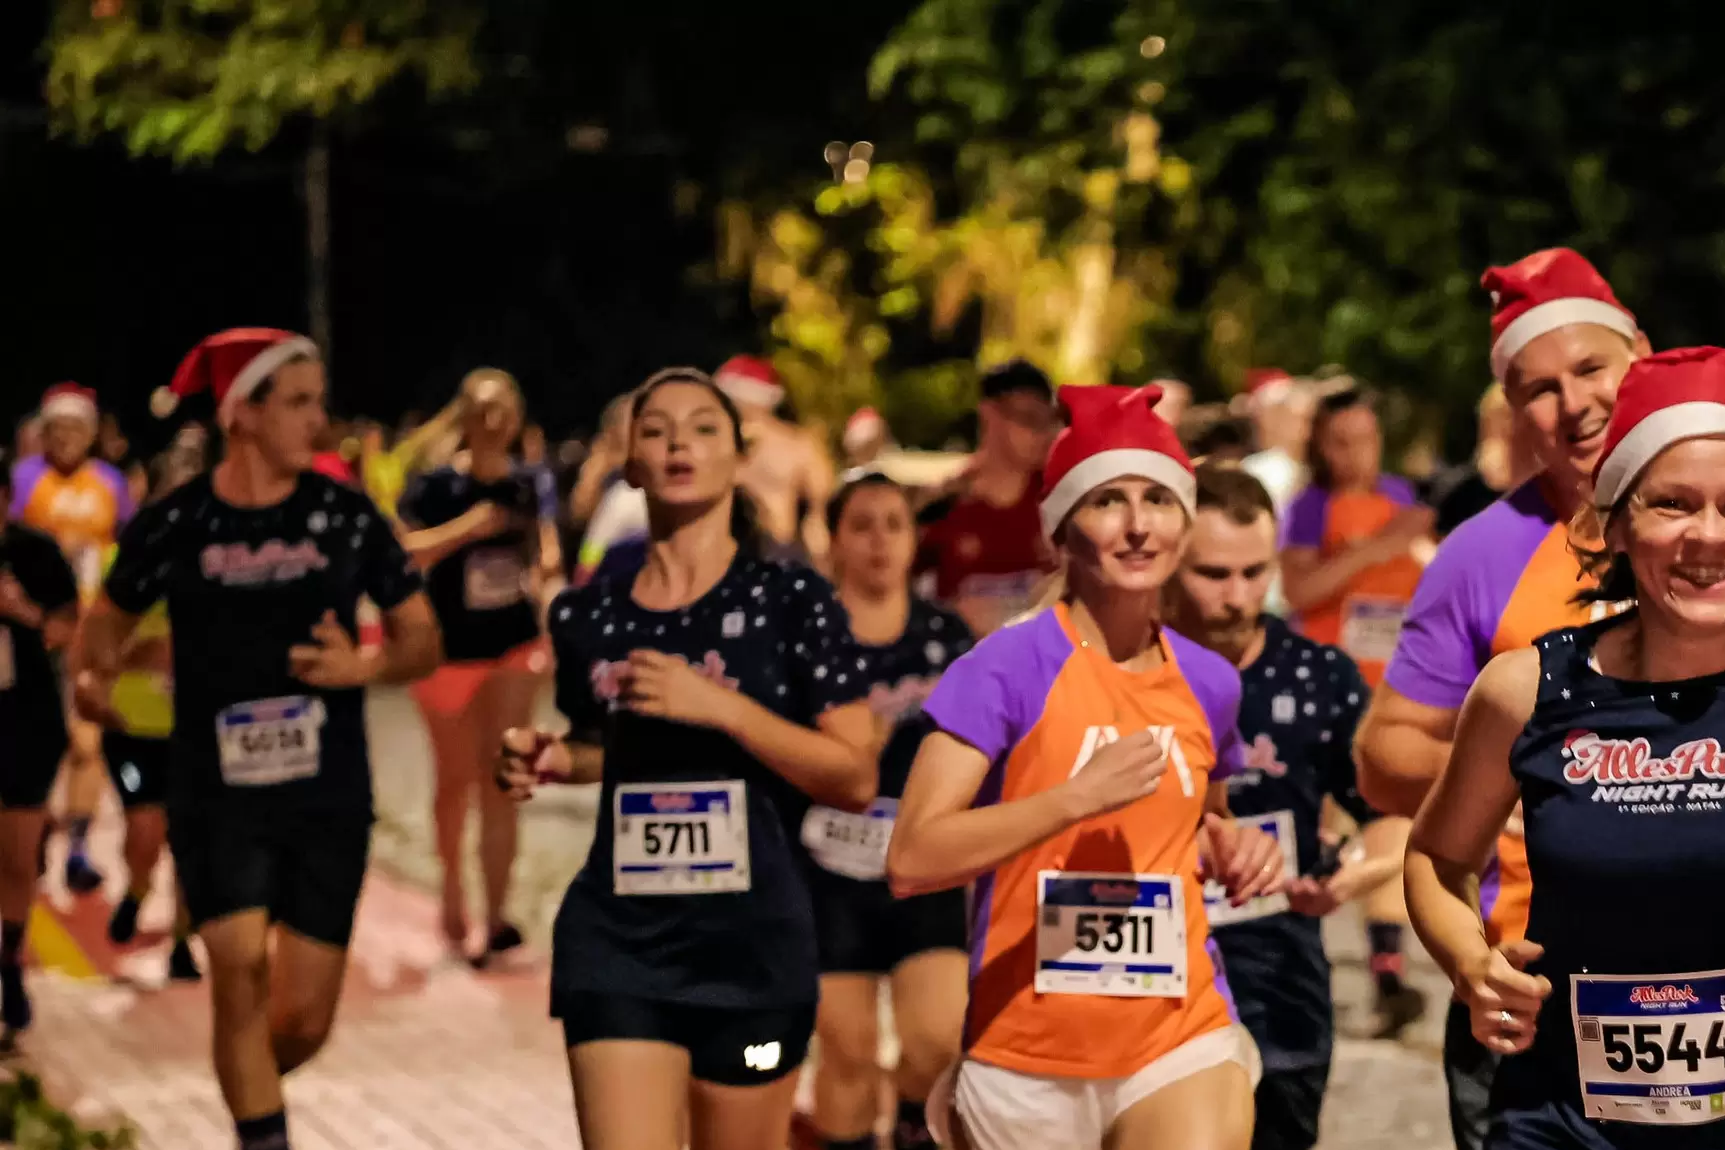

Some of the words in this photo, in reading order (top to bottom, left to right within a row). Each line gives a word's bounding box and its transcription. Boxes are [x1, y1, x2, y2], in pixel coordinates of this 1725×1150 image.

[1591, 784, 1685, 802] NIGHT
[644, 822, 710, 855] 5711
[1075, 913, 1153, 954] 5311
[1640, 1002, 1666, 1010] NIGHT
[1668, 1001, 1688, 1009] RUN
[1649, 1086, 1691, 1097] ANDREA
